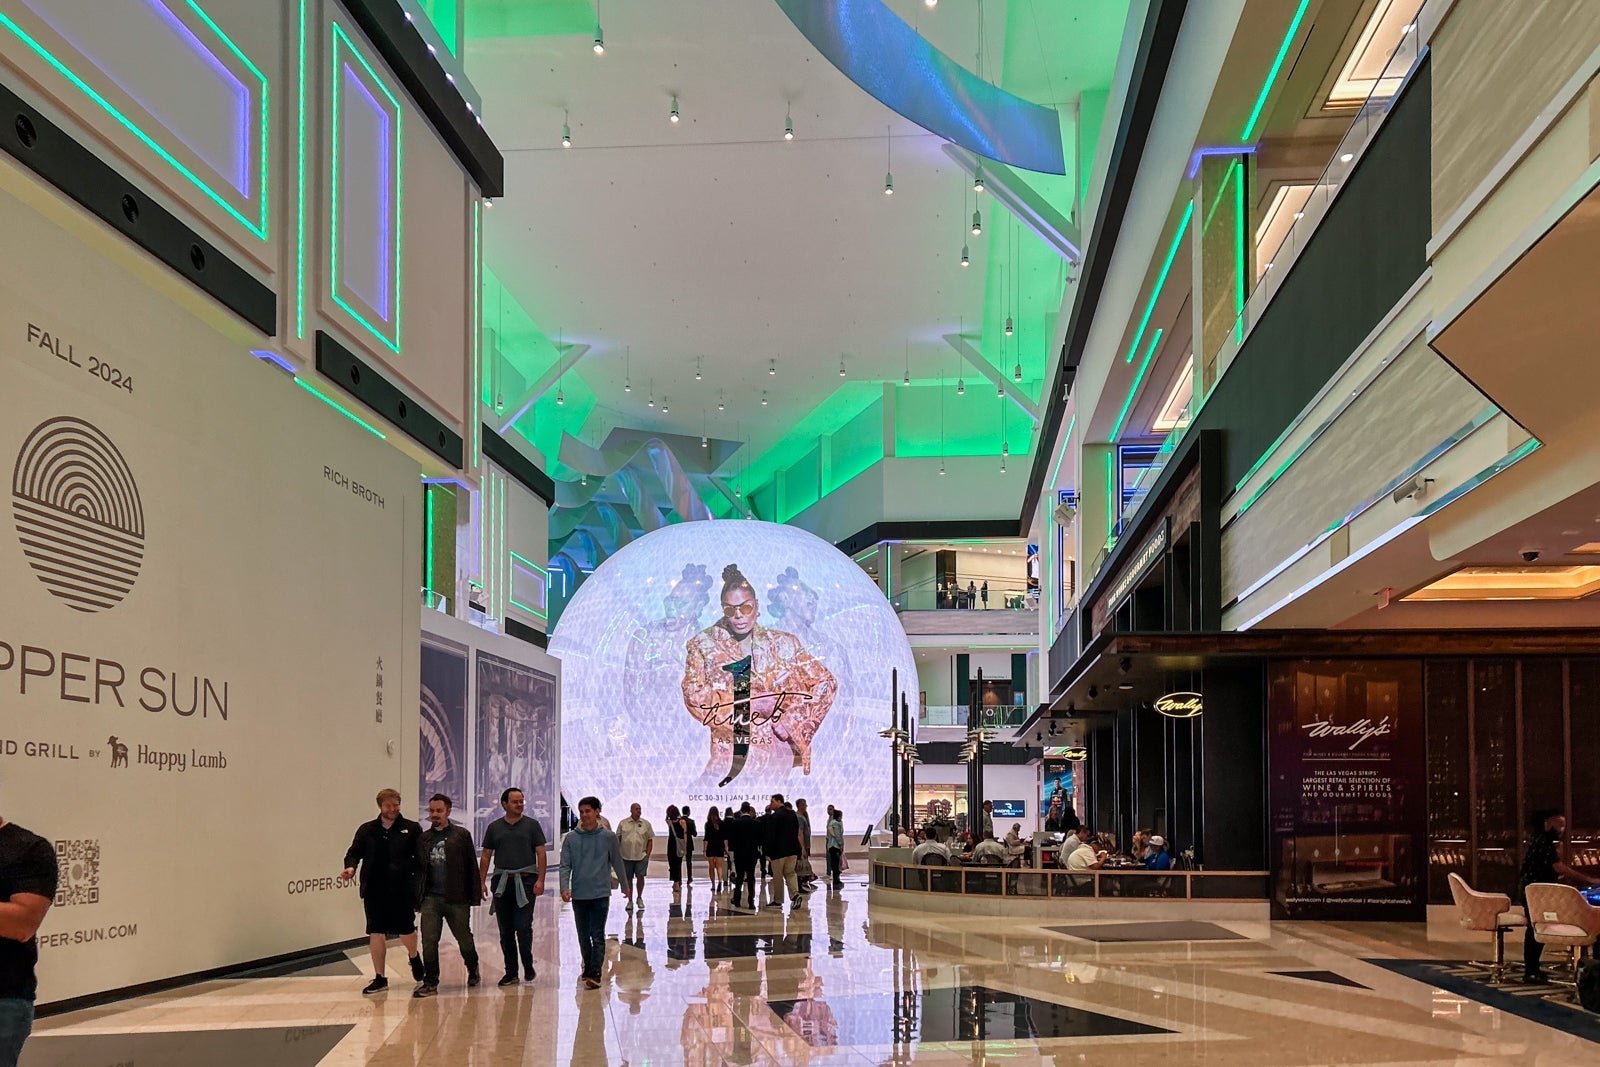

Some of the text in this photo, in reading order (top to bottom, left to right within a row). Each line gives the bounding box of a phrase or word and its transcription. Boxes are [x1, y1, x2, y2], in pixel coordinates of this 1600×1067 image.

[27, 322, 134, 394] FALL 2024
[323, 465, 385, 509] RICH BROTH
[1148, 529, 1165, 557] FOODS
[138, 666, 228, 721] SUN
[711, 735, 773, 745] LAS VEGAS
[1301, 715, 1391, 751] Wally's
[0, 739, 101, 760] D GRILL BY
[137, 743, 228, 773] Happy Lamb
[35, 924, 138, 949] PER-SUN.COM
